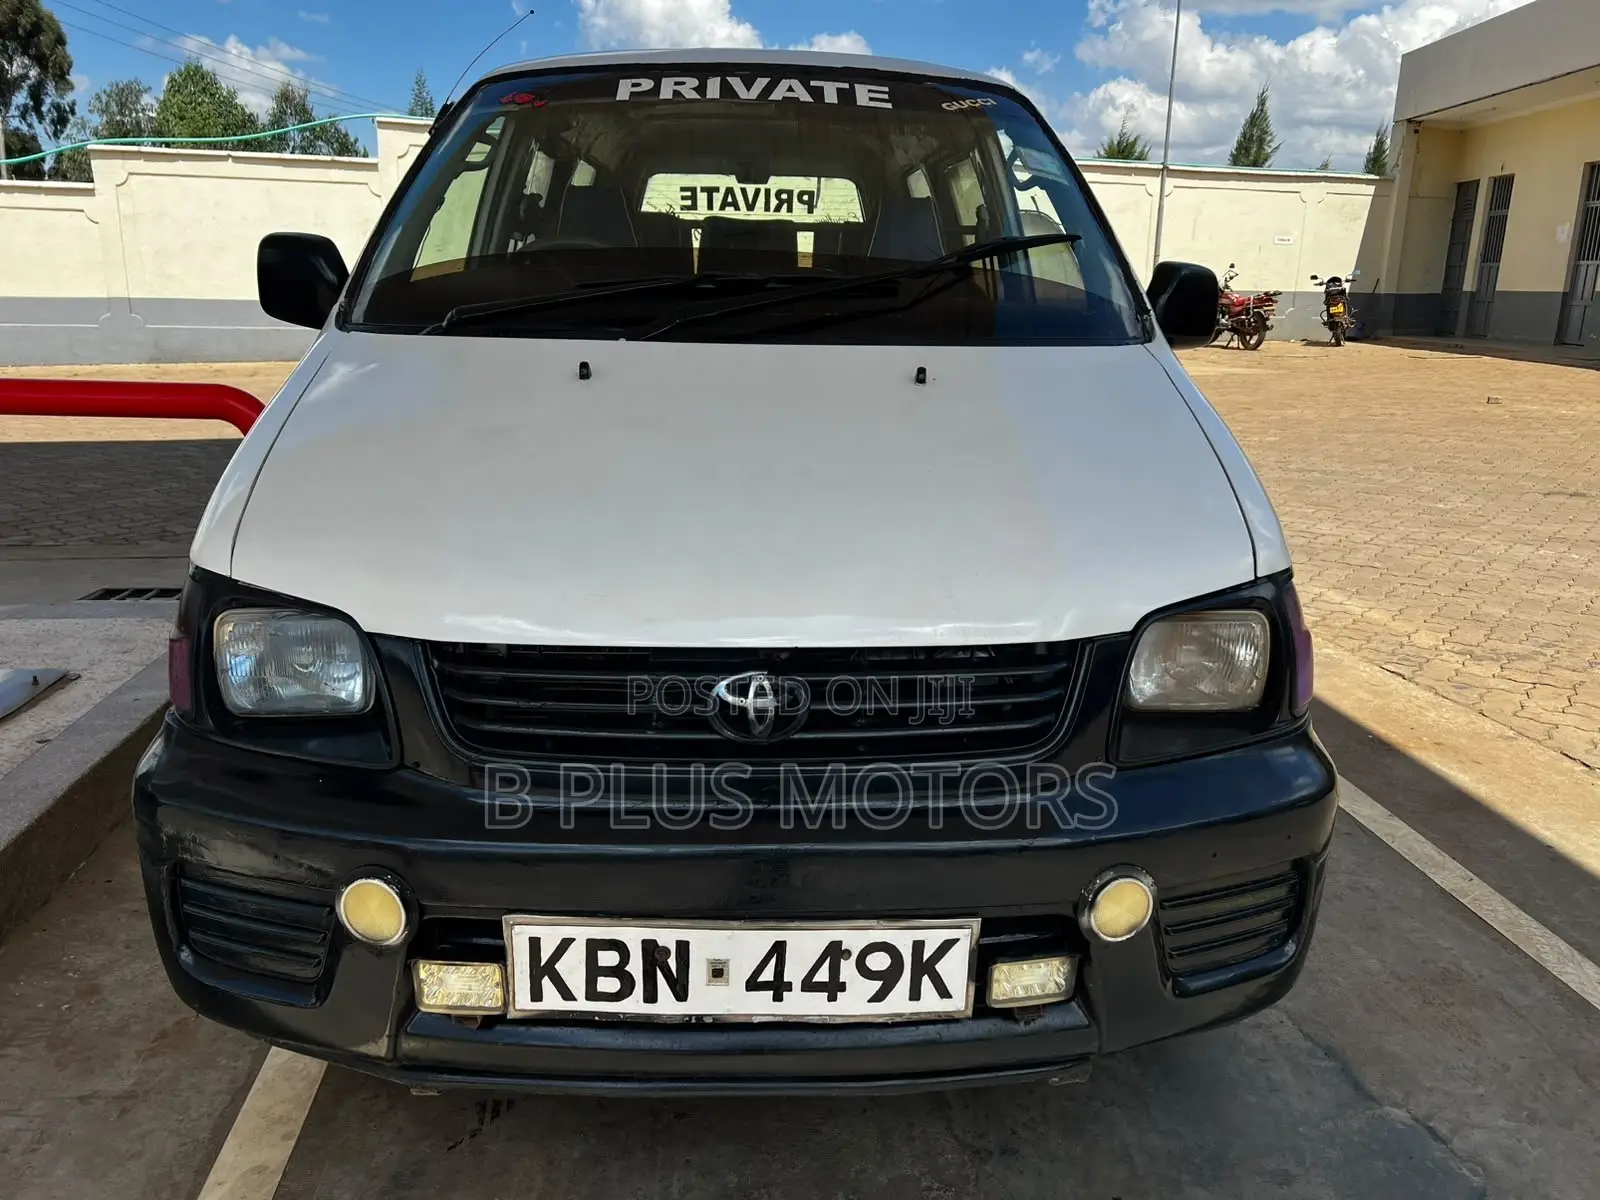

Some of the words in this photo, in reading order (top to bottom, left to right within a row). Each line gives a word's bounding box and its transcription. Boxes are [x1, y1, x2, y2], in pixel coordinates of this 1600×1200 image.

[616, 76, 893, 109] PRIVATE
[941, 98, 997, 111] GUCCI
[528, 936, 691, 1004] KBN
[744, 937, 961, 1004] 449K
